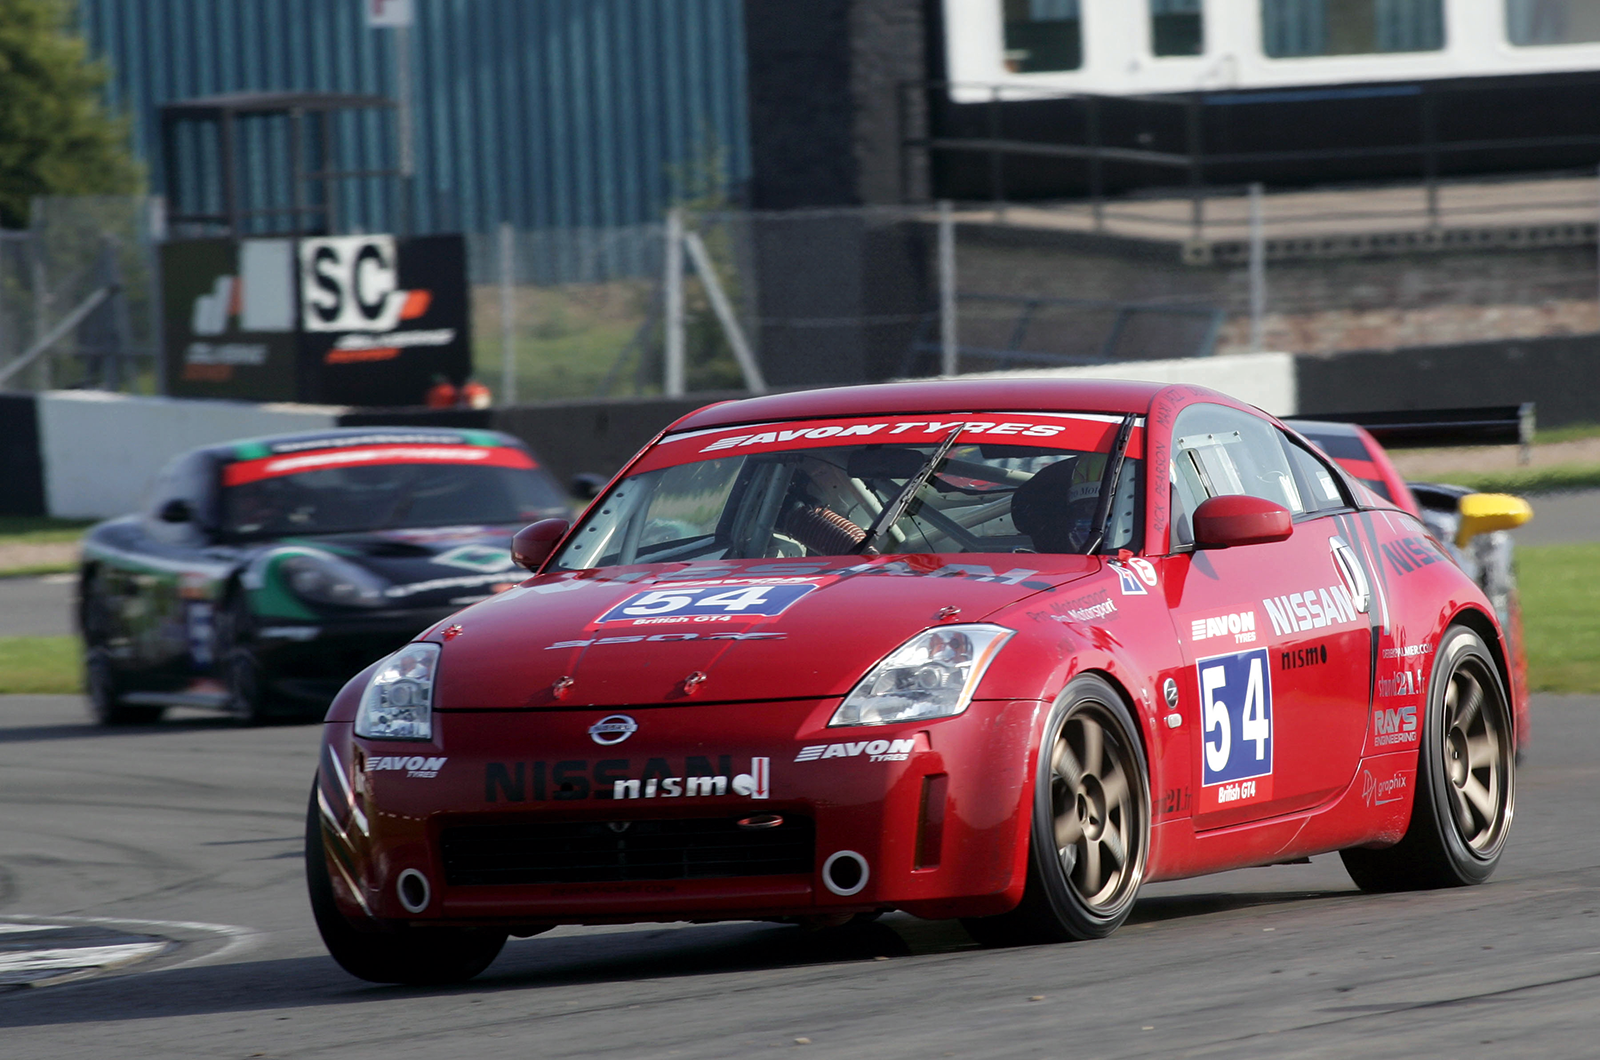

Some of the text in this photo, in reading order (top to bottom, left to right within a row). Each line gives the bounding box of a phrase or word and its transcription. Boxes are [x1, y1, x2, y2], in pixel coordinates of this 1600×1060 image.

[311, 244, 391, 323] SC
[738, 421, 1067, 448] AVON TYRES
[622, 586, 777, 616] 54
[1067, 597, 1118, 621] Motorsport
[1262, 584, 1358, 637] NISSAN
[632, 614, 732, 626] British GT4
[1206, 611, 1256, 638] AVON
[1234, 631, 1257, 644] TYRES
[1201, 657, 1269, 773] 54
[1373, 705, 1418, 737] RAYS
[820, 738, 915, 759] AVON
[1373, 731, 1417, 748] ENGINEERING
[376, 756, 448, 771] AVON
[869, 752, 909, 763] TYRES
[406, 770, 438, 779] TYRES
[485, 754, 732, 803] NISSAN
[1377, 773, 1407, 797] graphix
[1217, 780, 1257, 804] British GT4
